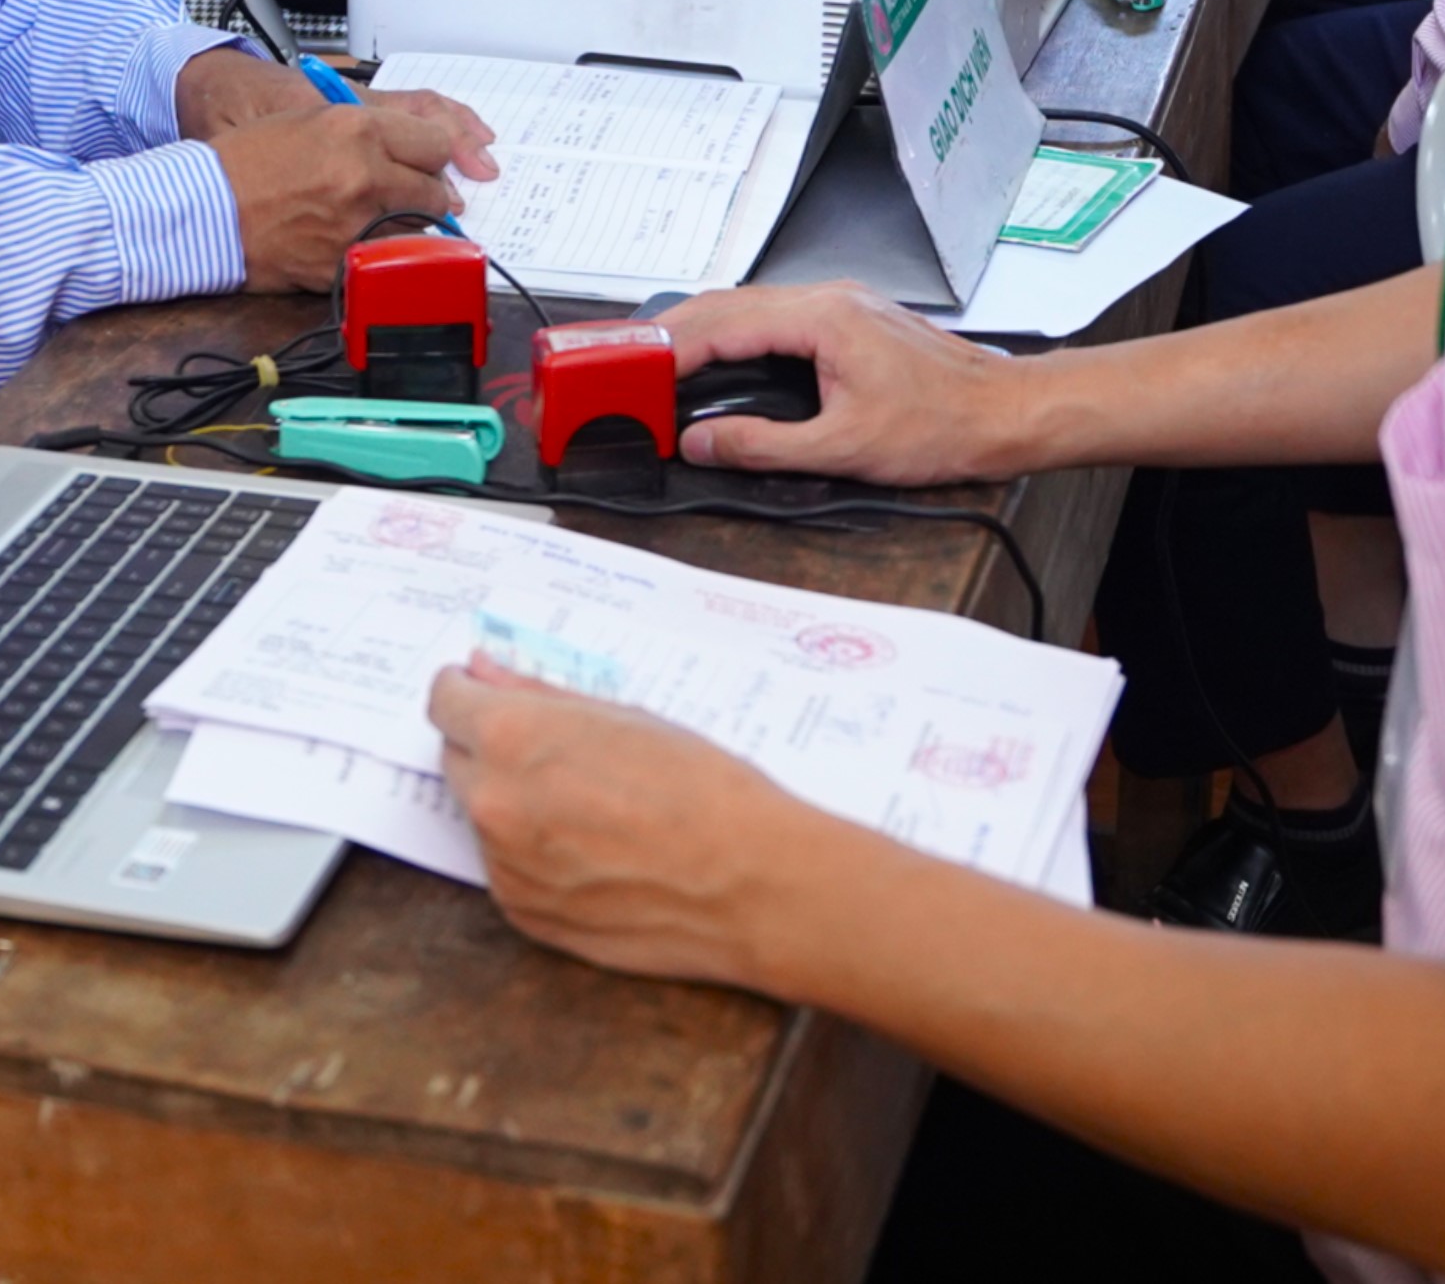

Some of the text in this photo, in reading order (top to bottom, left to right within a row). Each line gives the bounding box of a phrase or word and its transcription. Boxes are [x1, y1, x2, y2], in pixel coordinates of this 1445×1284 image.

[929, 27, 992, 163] GIAO DỊCH VIÊN
